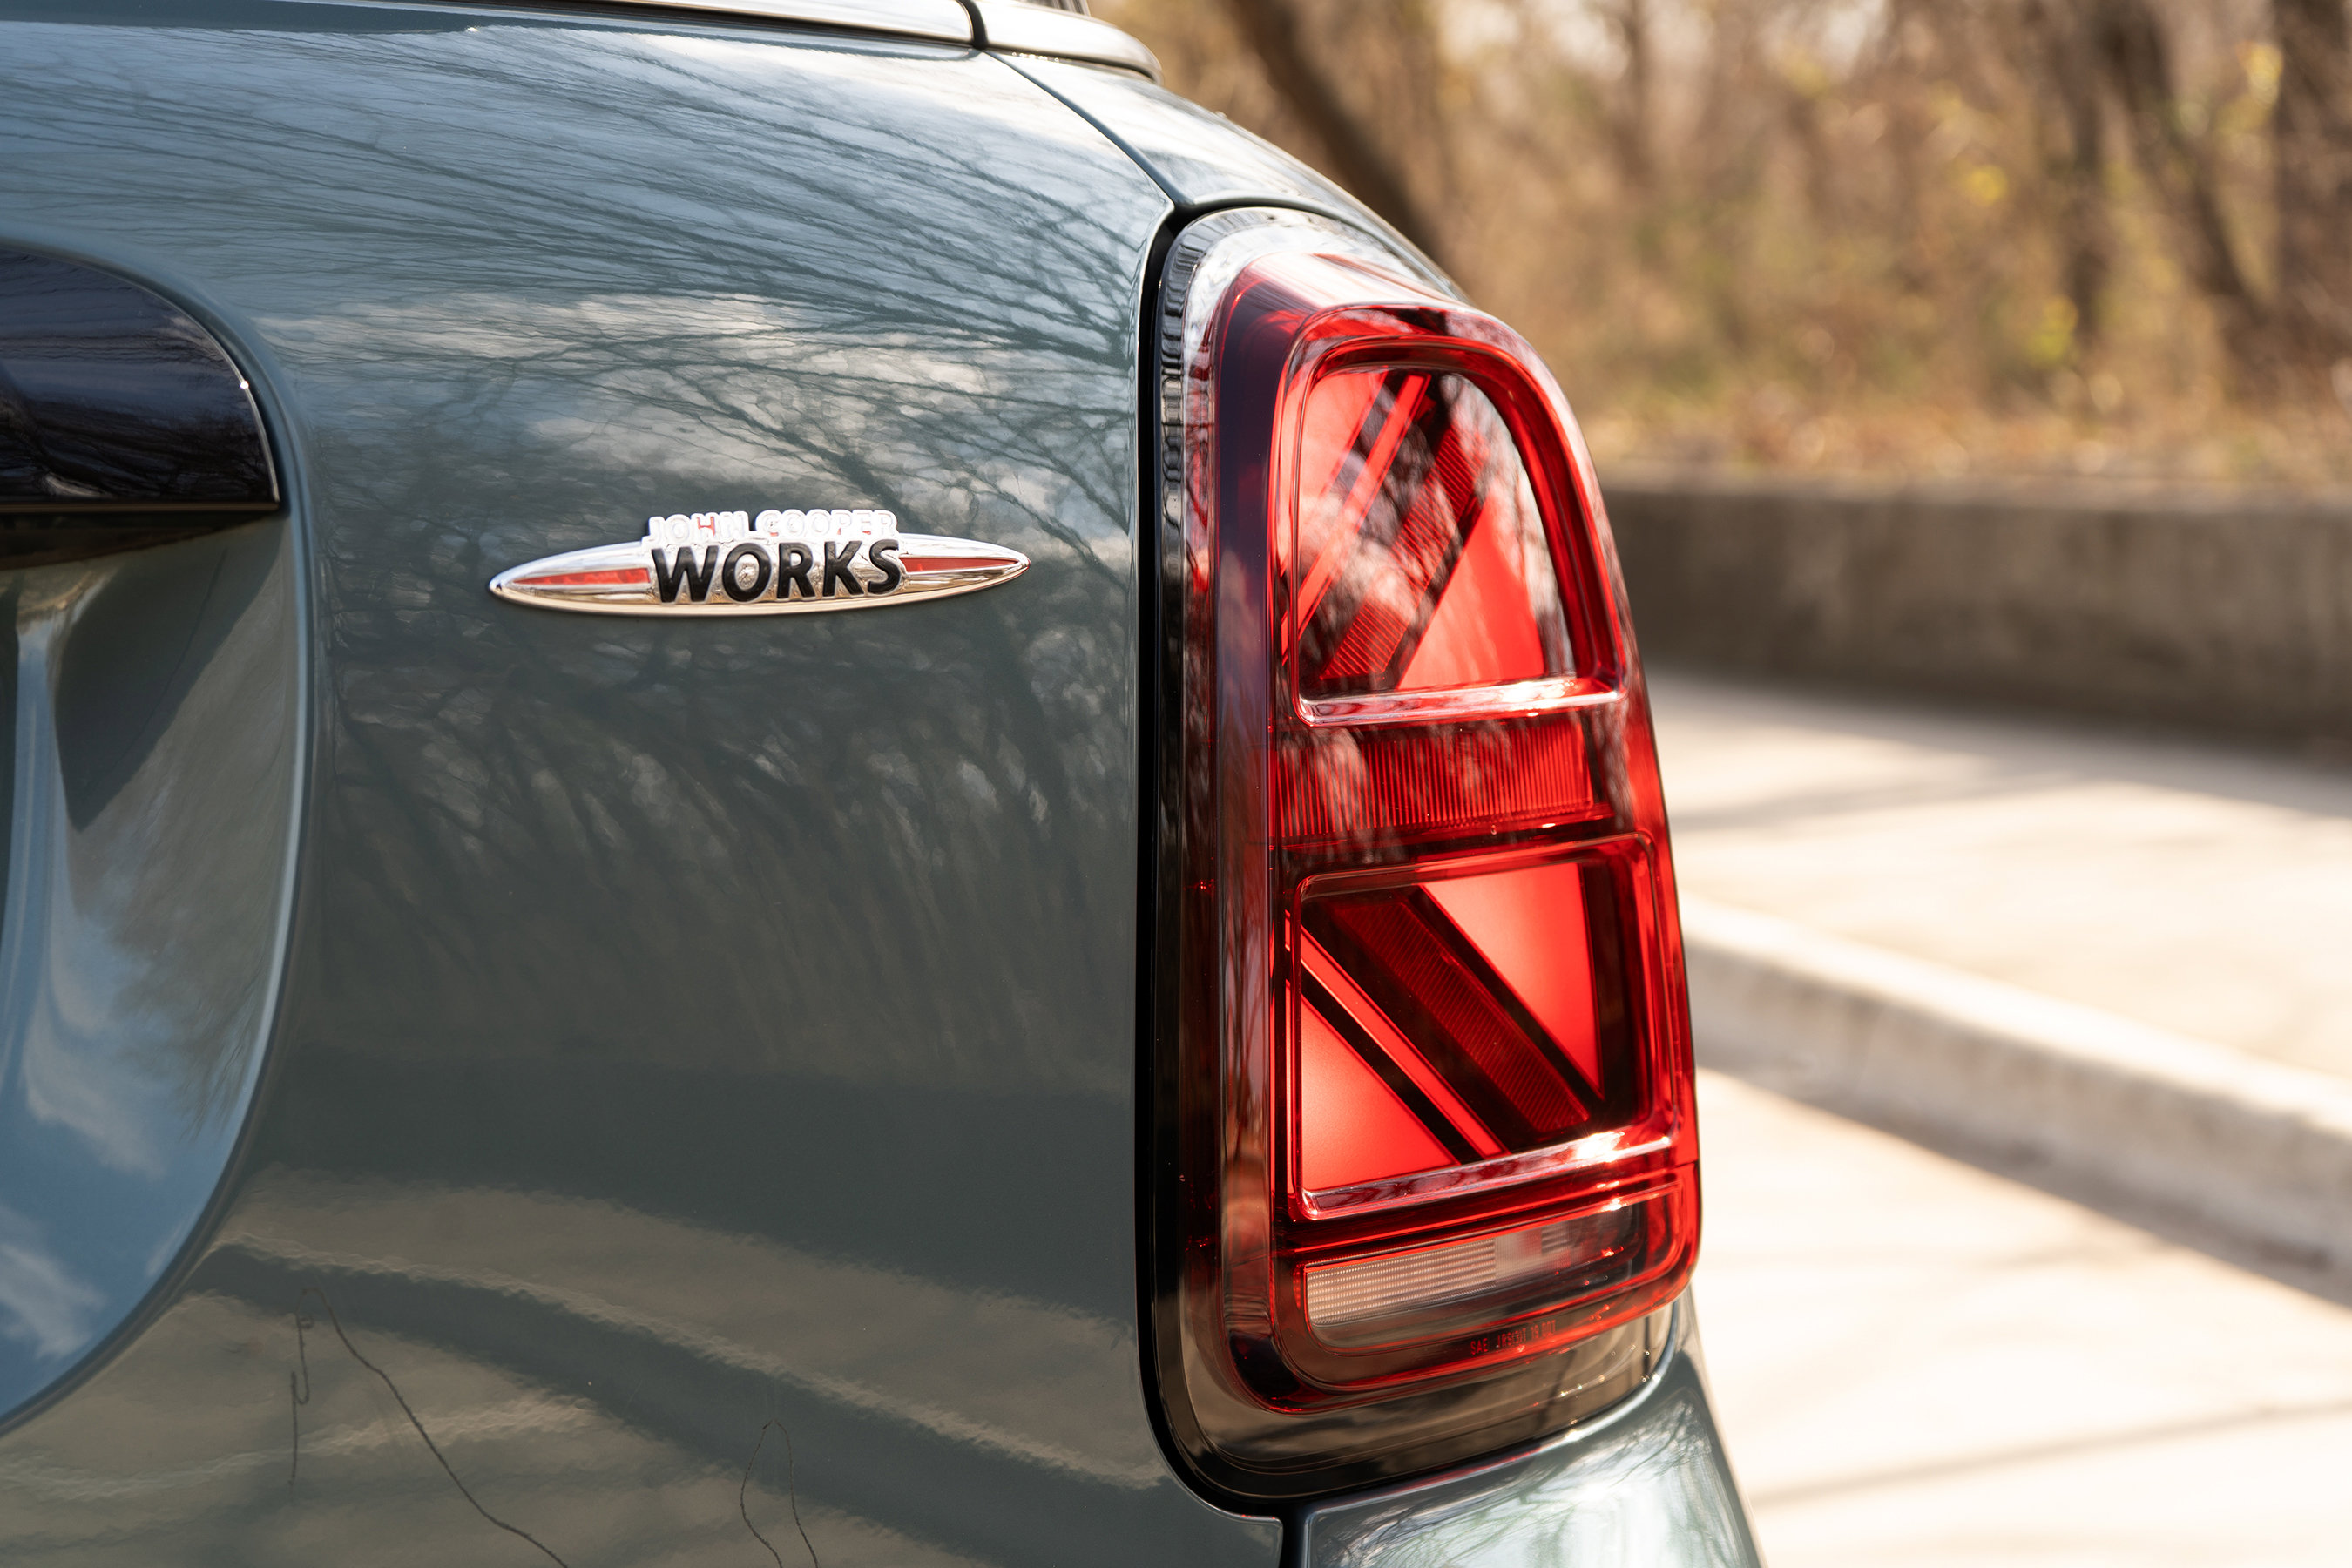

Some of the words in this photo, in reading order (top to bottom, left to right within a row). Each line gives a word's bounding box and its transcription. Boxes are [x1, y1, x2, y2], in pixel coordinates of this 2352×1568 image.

[651, 514, 748, 542] JOHN
[757, 510, 896, 538] COOPER
[652, 539, 902, 603] WORKS
[1470, 1337, 1488, 1355] SAE
